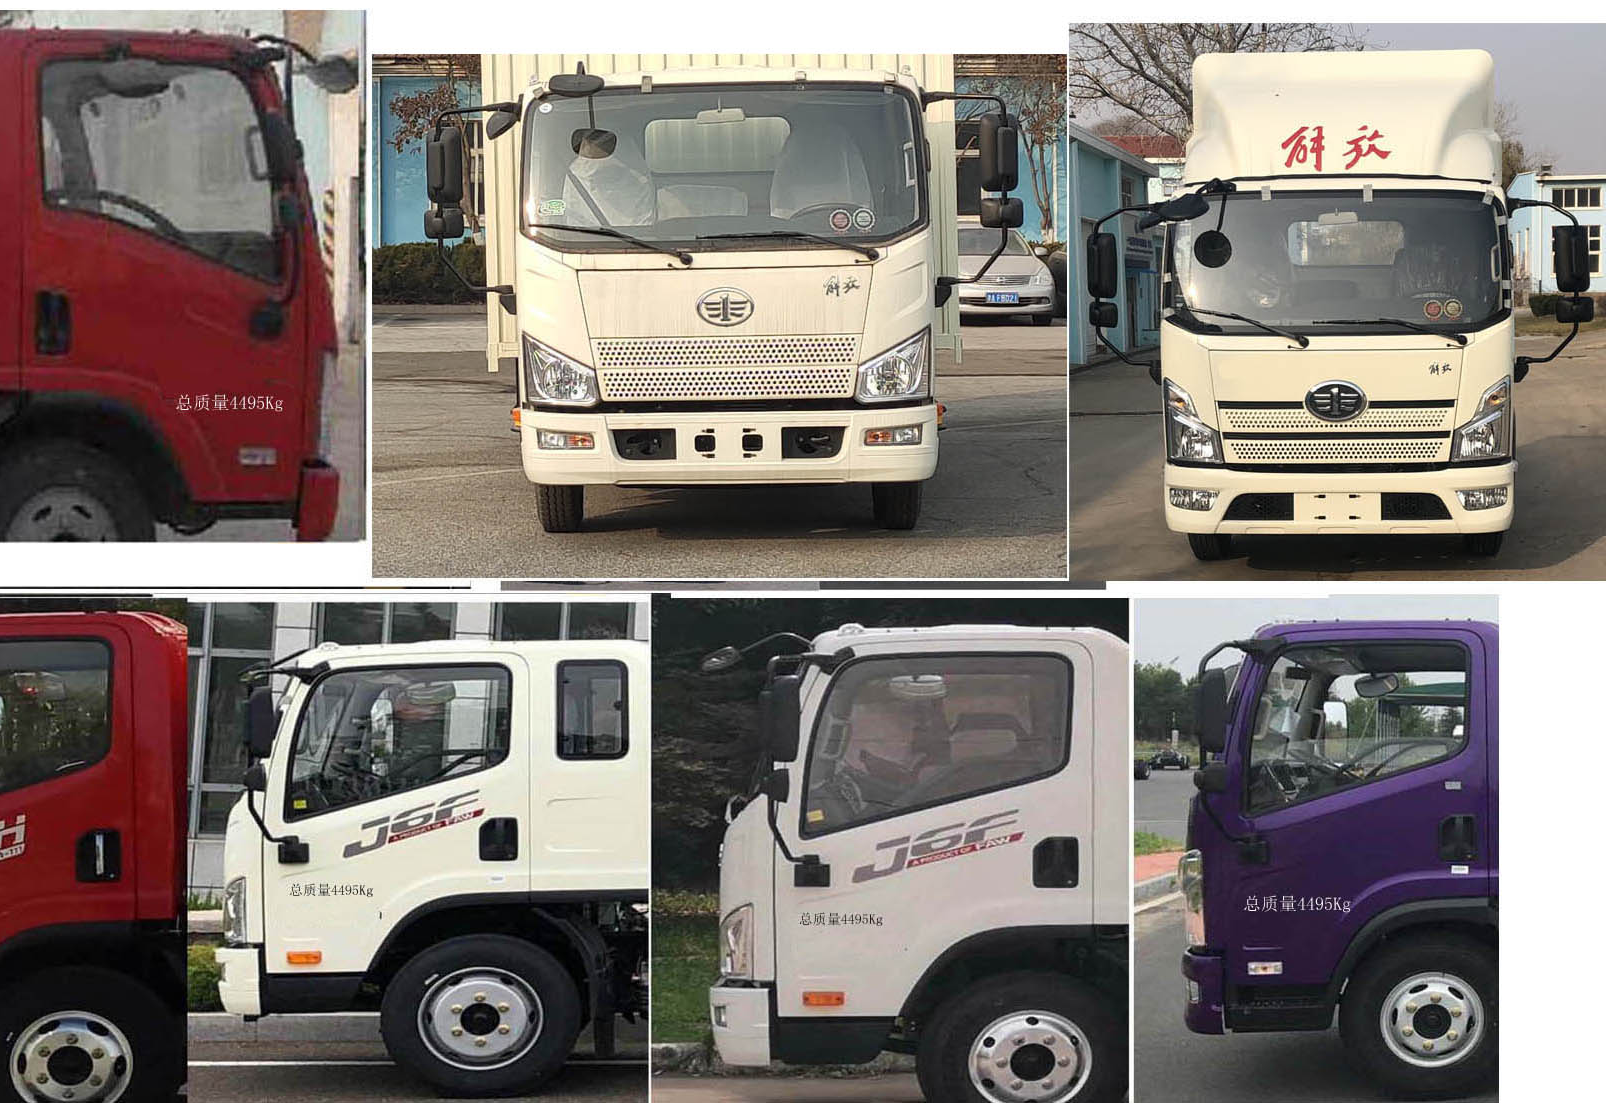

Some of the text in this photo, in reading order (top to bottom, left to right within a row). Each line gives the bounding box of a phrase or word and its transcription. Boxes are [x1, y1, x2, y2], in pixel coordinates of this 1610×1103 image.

[1281, 125, 1391, 172] 解放
[445, 812, 475, 827] FAW
[975, 836, 1011, 851] FAW
